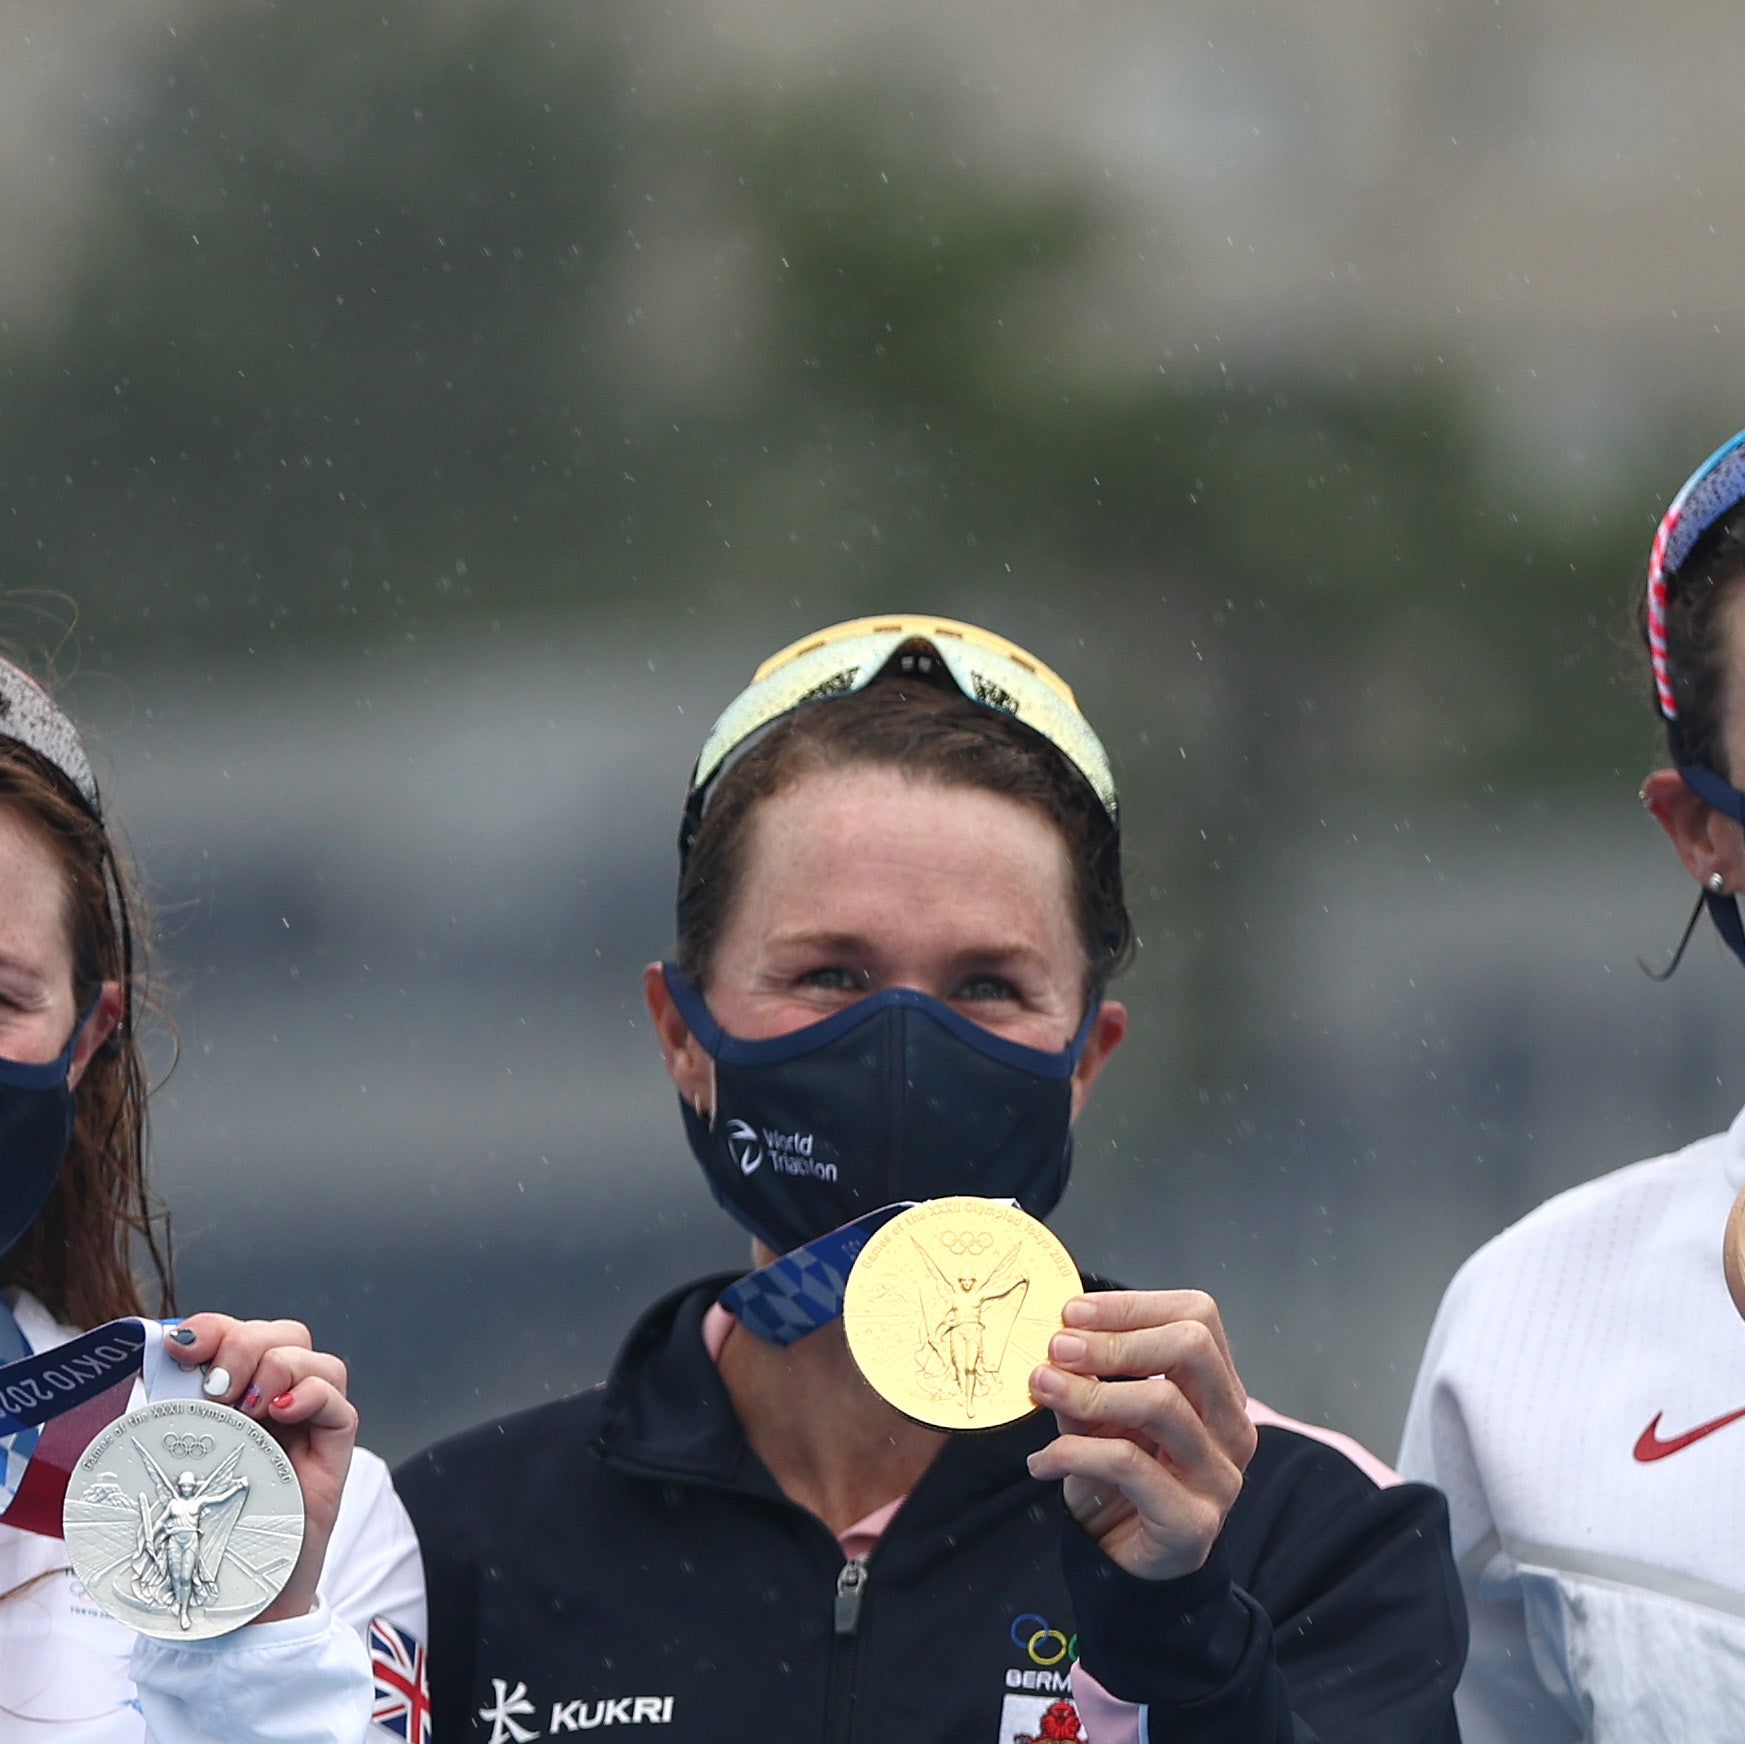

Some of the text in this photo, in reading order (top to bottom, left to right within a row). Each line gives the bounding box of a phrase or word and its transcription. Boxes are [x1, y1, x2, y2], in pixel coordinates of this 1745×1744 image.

[762, 1127, 813, 1156] World
[43, 1337, 145, 1391] TOKYO
[114, 1421, 127, 1437] of
[128, 1411, 150, 1428] the
[151, 1402, 185, 1419] XXXII
[188, 1403, 246, 1431] Olympiad
[247, 1424, 273, 1455] Tokyo
[271, 1454, 293, 1484] 2020
[1005, 1668, 1072, 1692] BERM
[549, 1696, 674, 1735] KUKRI
